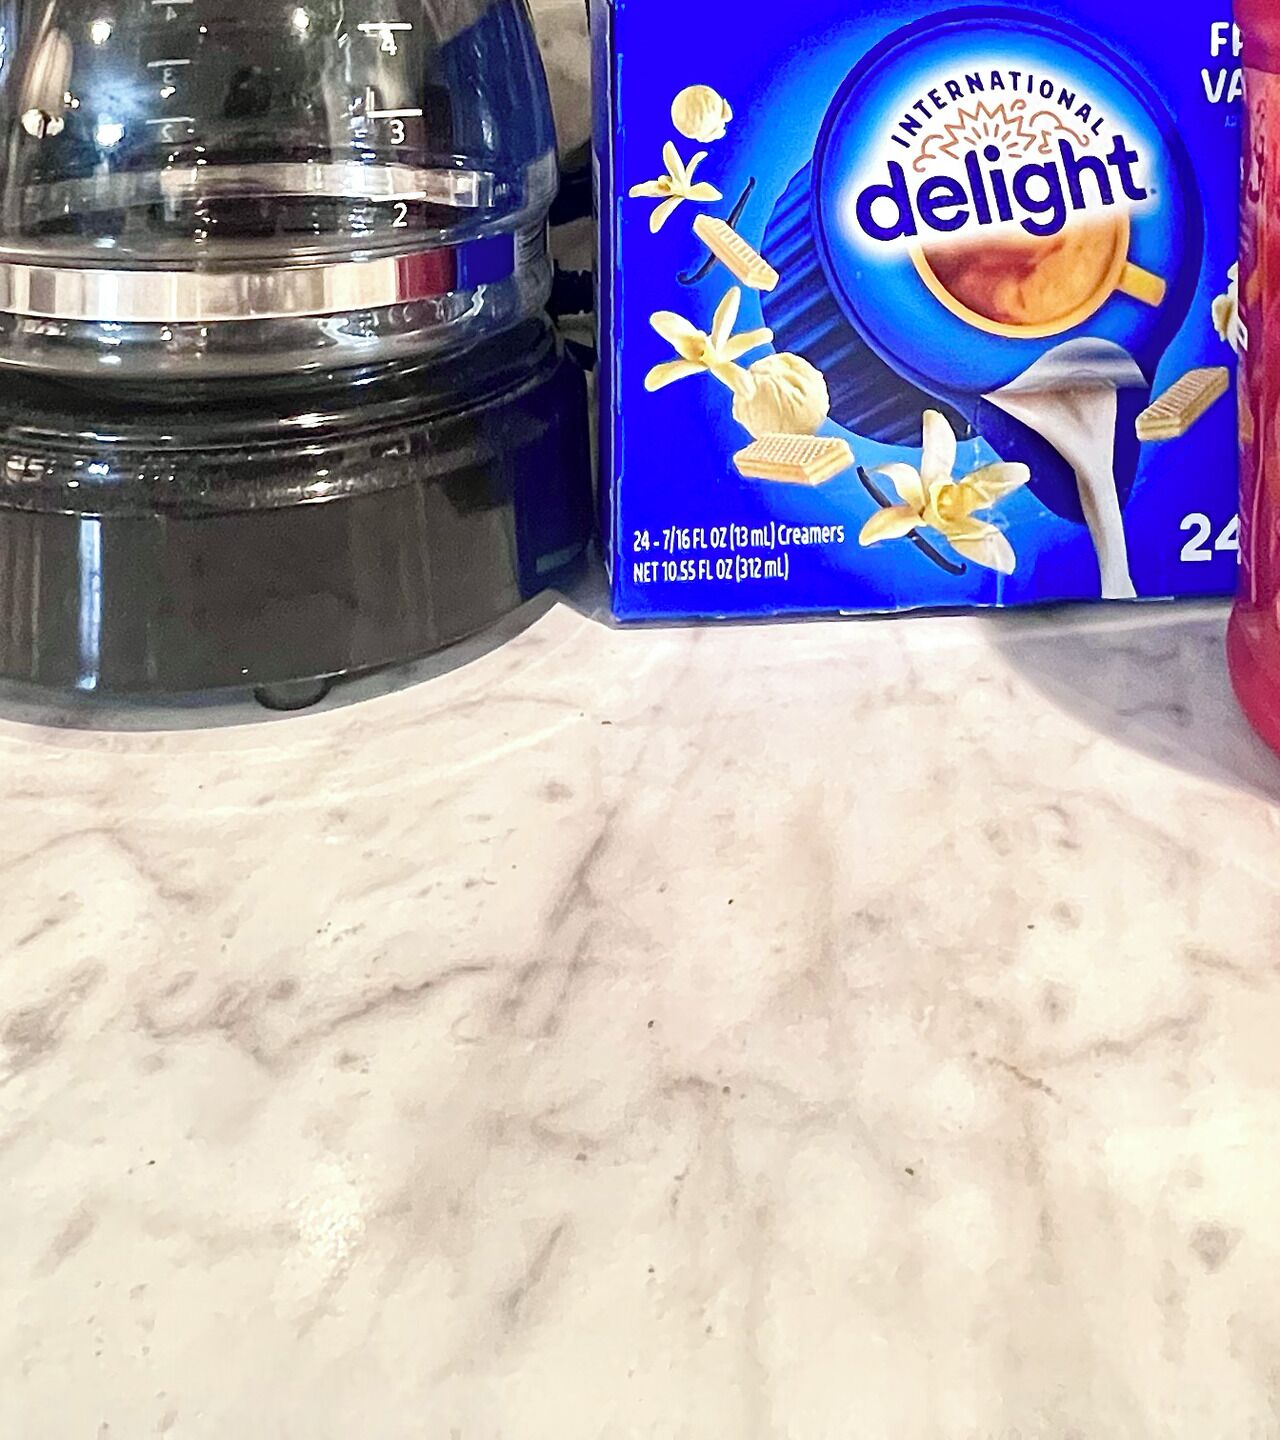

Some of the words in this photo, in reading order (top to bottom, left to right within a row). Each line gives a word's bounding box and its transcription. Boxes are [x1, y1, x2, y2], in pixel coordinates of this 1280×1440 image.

[379, 33, 399, 56] 4
[891, 70, 1104, 148] INTERNATIONAL
[390, 119, 405, 145] 3
[856, 135, 1147, 241] delight
[392, 202, 408, 228] 2
[633, 530, 650, 552] 24
[663, 526, 690, 553] 7/16
[693, 528, 708, 550] FL
[710, 527, 727, 549] OZ
[730, 523, 749, 551] (13
[751, 521, 775, 550] mL)
[778, 524, 845, 546] Creamers
[633, 561, 659, 583] NET
[662, 560, 696, 581] 10.55
[698, 559, 713, 580] FL
[716, 558, 733, 580] OZ
[735, 554, 761, 583] (312
[764, 553, 788, 581] mL)
